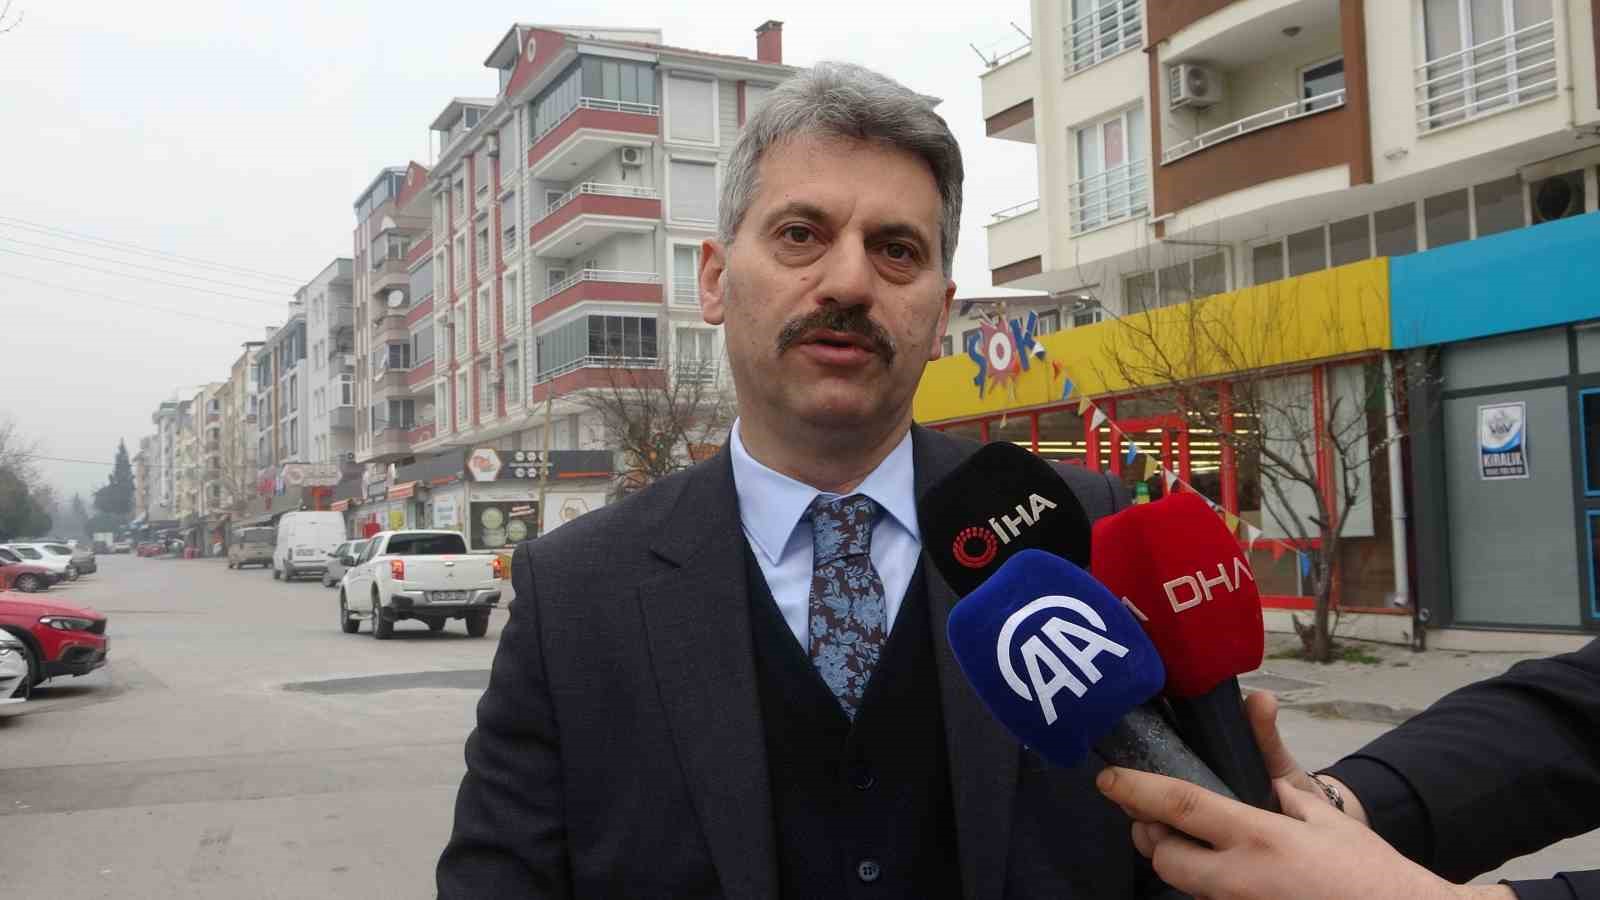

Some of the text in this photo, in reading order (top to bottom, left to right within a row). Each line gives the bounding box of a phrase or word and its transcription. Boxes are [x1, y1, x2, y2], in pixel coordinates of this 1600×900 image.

[988, 492, 1057, 545] İHA
[1162, 555, 1256, 614] DHA
[1020, 616, 1130, 726] AA
